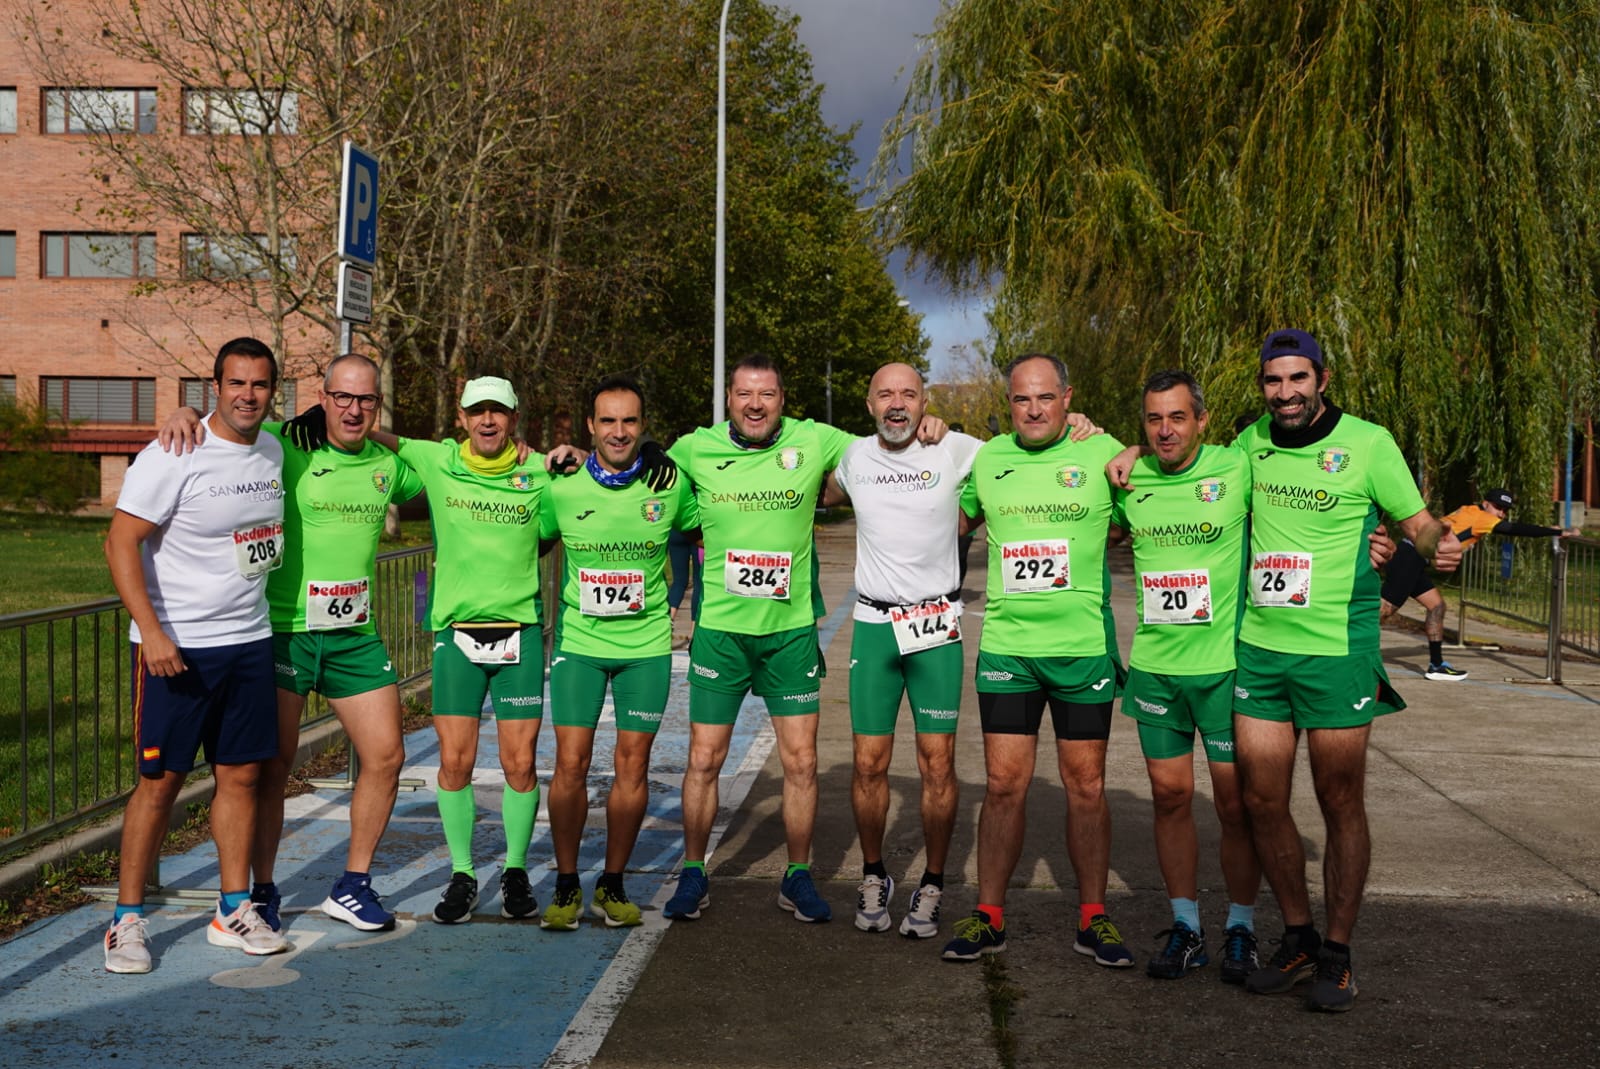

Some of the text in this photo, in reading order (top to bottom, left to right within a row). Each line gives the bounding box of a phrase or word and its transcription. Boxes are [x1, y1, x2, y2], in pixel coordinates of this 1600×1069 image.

[351, 163, 372, 245] P
[855, 470, 932, 487] SANMAXIMO
[209, 479, 278, 498] SANMAXIMO
[711, 489, 795, 504] SANMAXIMO
[1254, 481, 1328, 501] ANMAXIMO
[446, 496, 527, 514] SANMAXIMO
[738, 500, 791, 512] TELECOM
[999, 502, 1081, 516] SANMAXIMO
[1266, 494, 1319, 512] TELECOM
[471, 511, 521, 525] TELECOM
[1025, 513, 1075, 524] TELECOM
[1134, 521, 1212, 538] ANMAXIMO
[574, 540, 655, 552] SANMAXIMO
[1152, 534, 1206, 548] TELECOM
[247, 539, 277, 564] 208
[600, 551, 650, 562] TELECOM
[727, 551, 790, 568] bedunia
[1003, 545, 1068, 560] bedunia
[580, 570, 643, 585] bedunia
[738, 567, 777, 588] 284
[1014, 558, 1055, 580] 292
[1143, 573, 1208, 589] bedunia
[1261, 571, 1286, 592] 26
[593, 586, 631, 604] 194
[1161, 590, 1188, 610] 20
[327, 597, 354, 616] 66
[908, 615, 948, 639] 144
